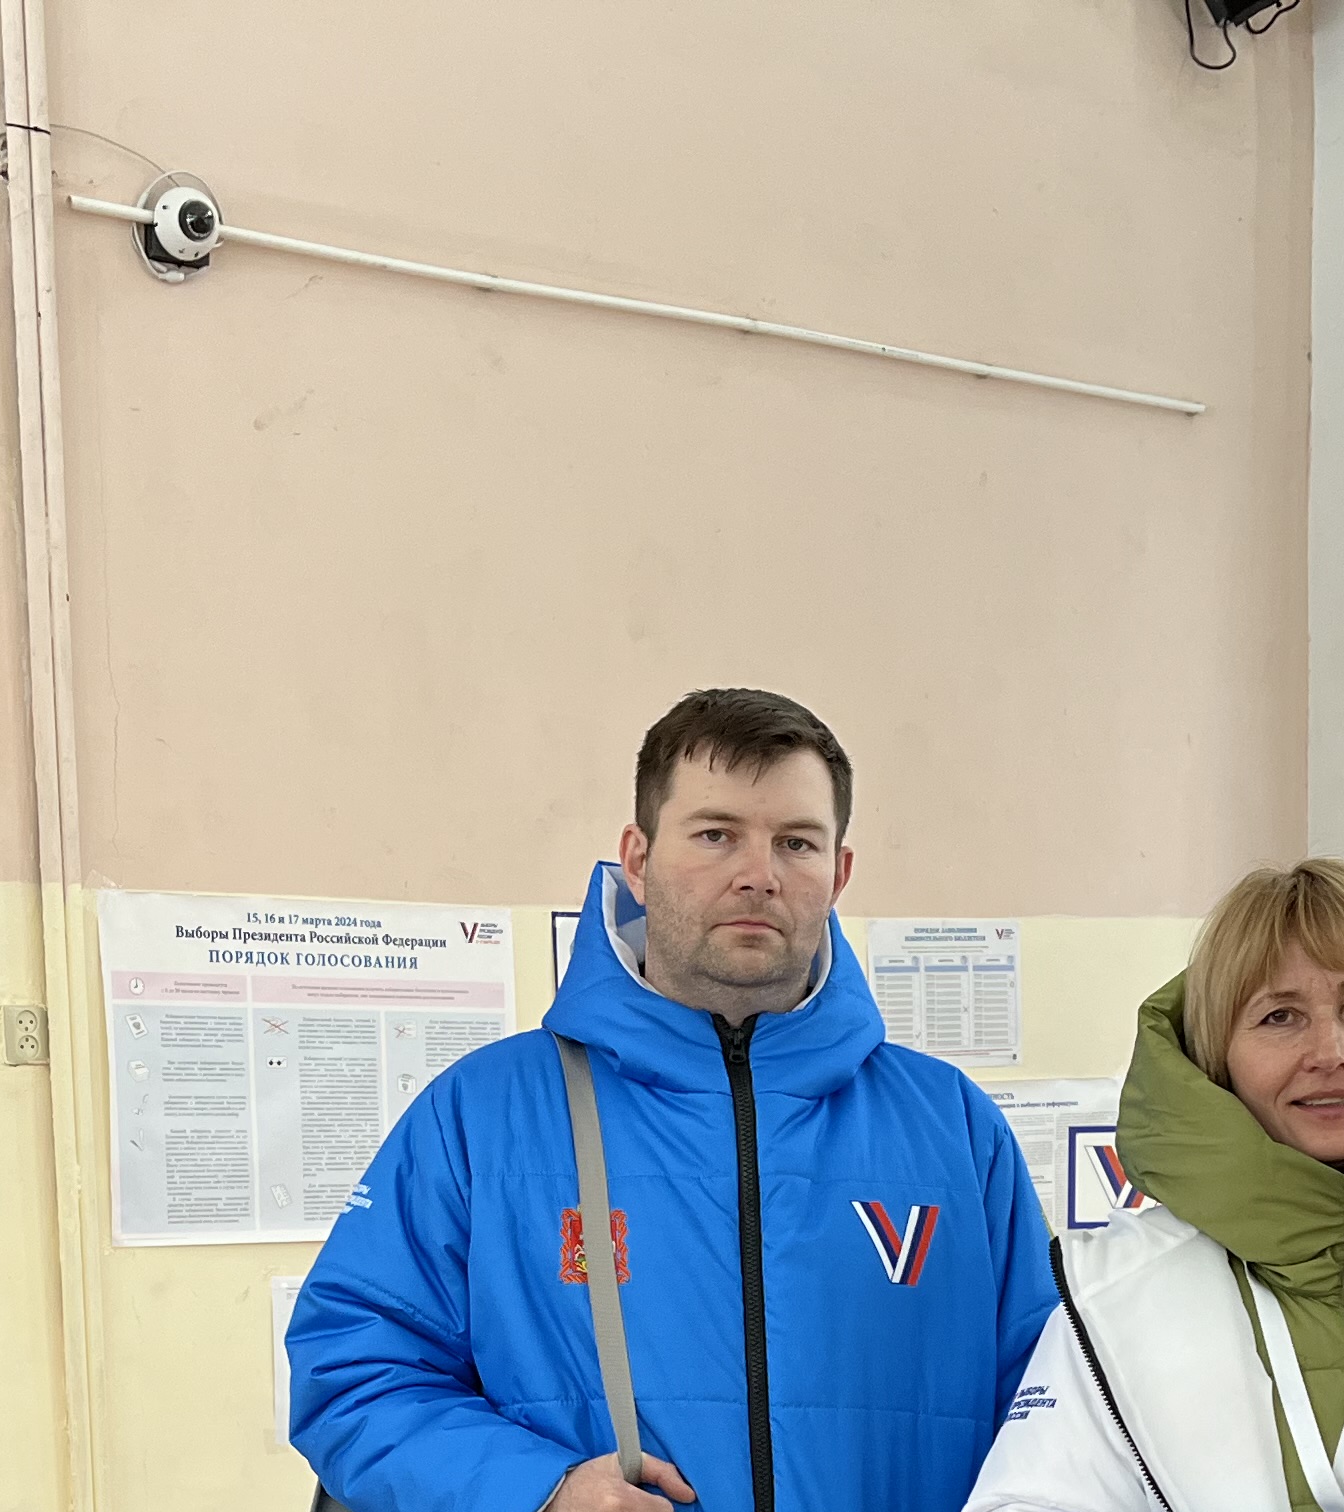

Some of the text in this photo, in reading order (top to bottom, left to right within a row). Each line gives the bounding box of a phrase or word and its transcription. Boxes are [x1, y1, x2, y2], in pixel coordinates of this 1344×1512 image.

[246, 912, 382, 929] 15, 16 и 17 марта 2024 года
[175, 925, 447, 950] Выборы Президента Российской Федерации
[208, 949, 418, 970] ПОРЯДОК ГОЛОСОВАНИЯ
